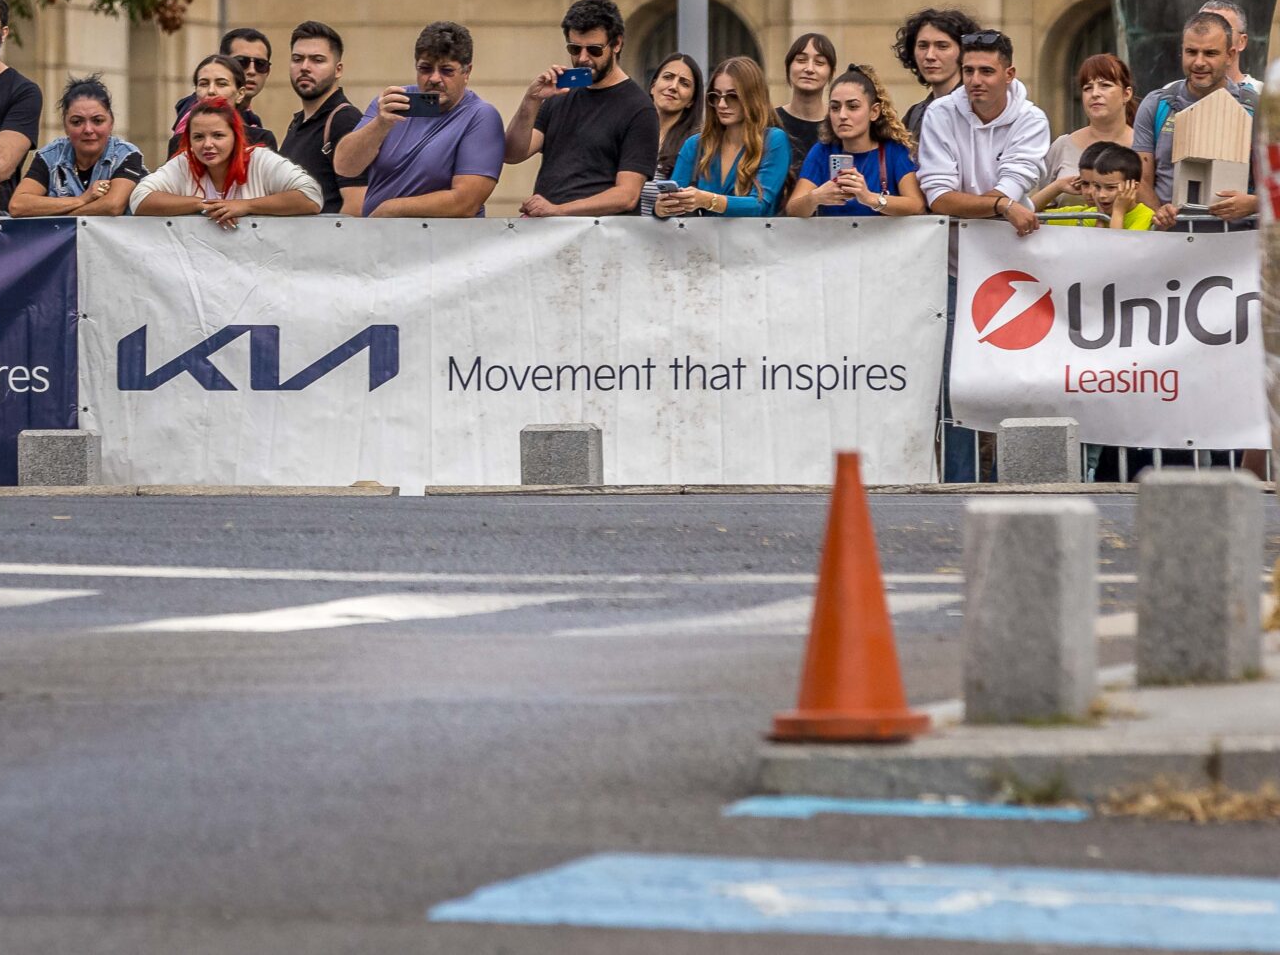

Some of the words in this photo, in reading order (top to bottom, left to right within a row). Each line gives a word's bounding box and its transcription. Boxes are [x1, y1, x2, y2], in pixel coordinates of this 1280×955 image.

[117, 323, 400, 392] KIA
[447, 355, 657, 392] Movement
[669, 355, 747, 392] that
[761, 355, 908, 400] inspires
[1064, 361, 1179, 402] Leasing
